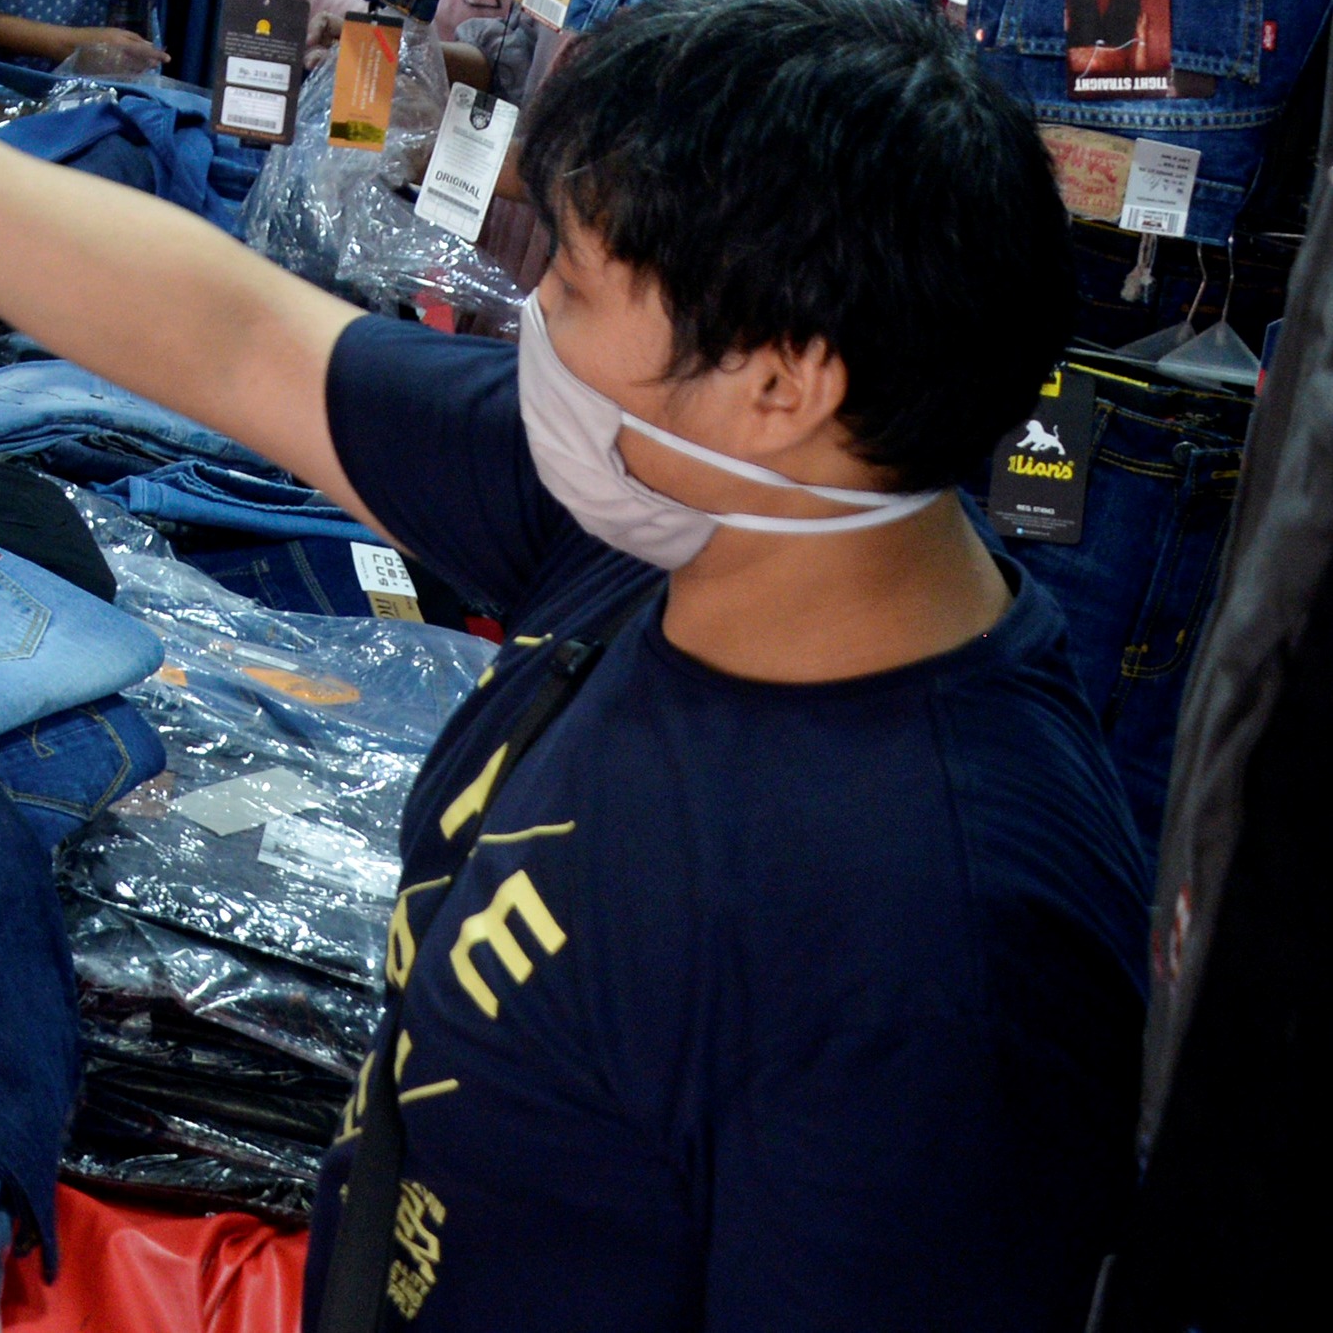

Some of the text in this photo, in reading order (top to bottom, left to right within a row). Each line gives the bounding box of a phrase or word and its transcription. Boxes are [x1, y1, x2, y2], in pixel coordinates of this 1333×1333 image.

[1074, 77, 1168, 92] TIGHT STRAIGHT
[435, 169, 481, 200] ORIGINAL
